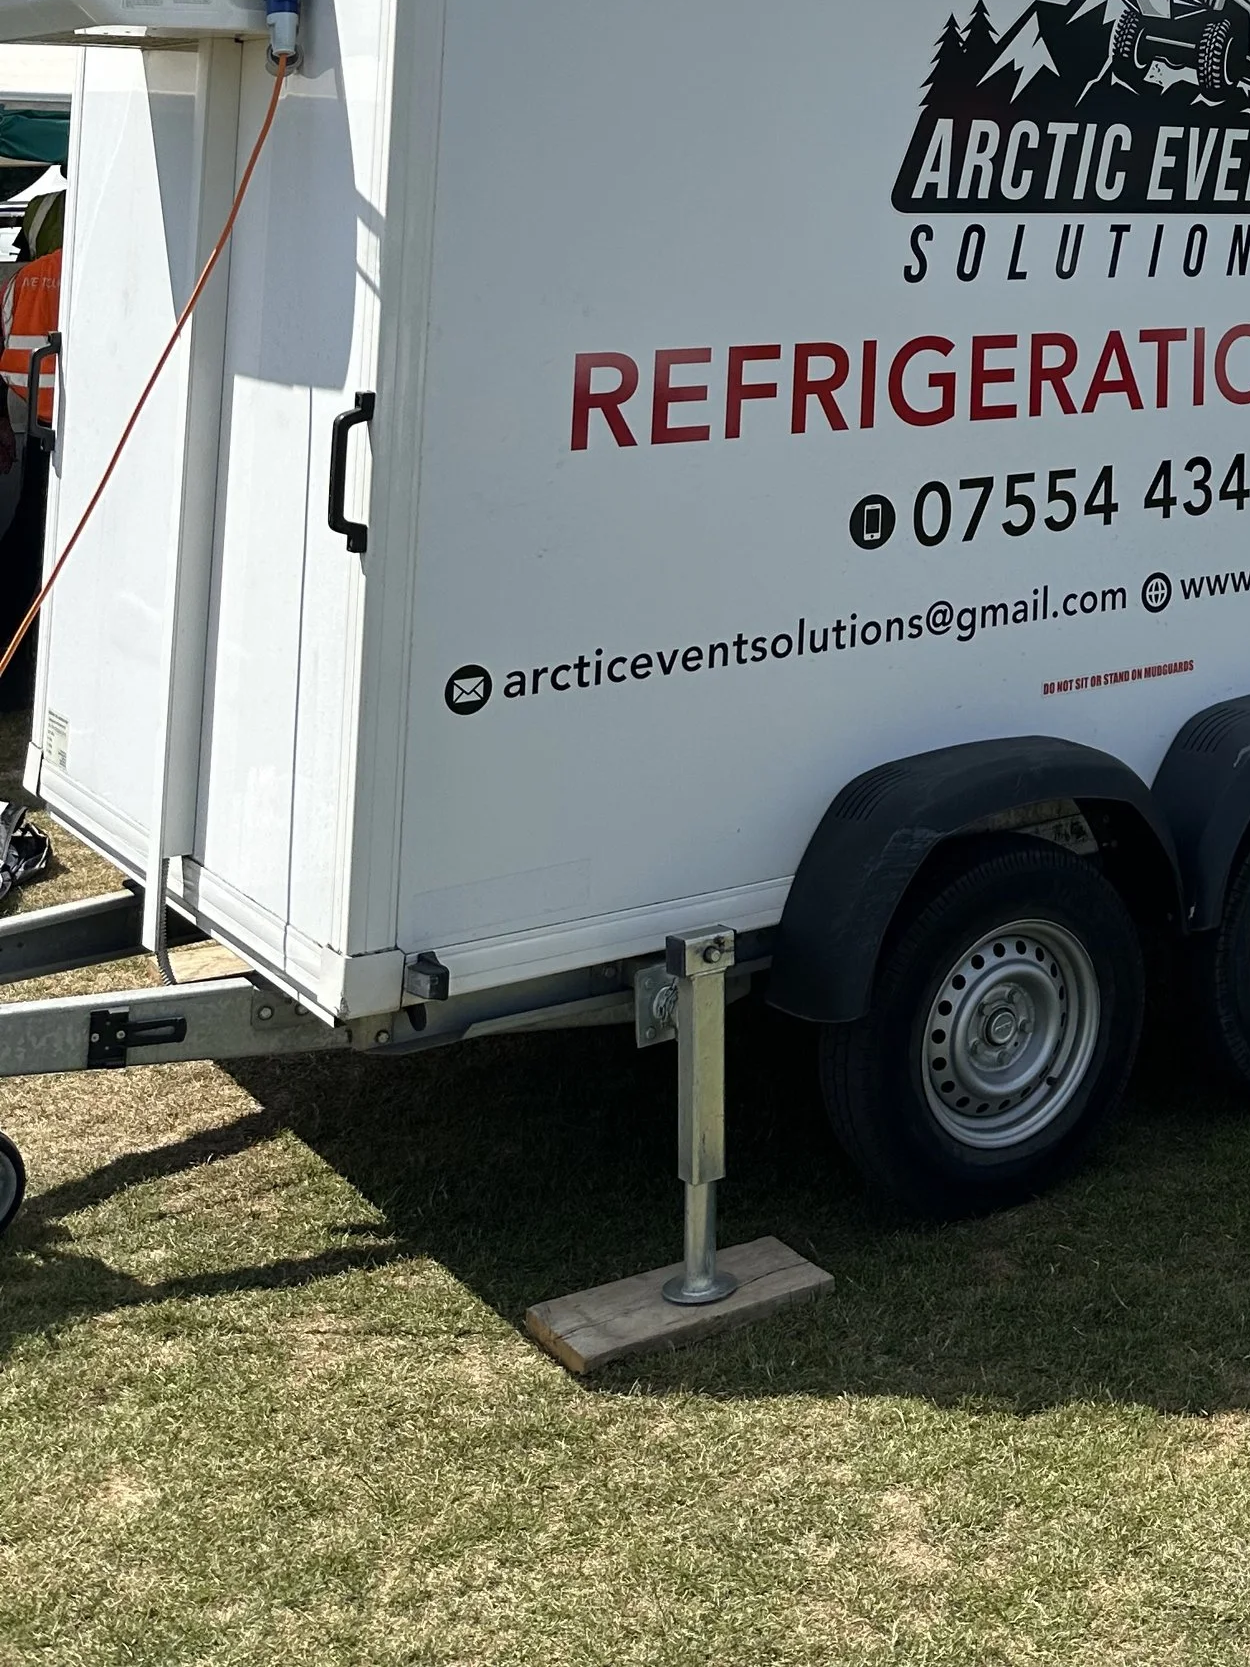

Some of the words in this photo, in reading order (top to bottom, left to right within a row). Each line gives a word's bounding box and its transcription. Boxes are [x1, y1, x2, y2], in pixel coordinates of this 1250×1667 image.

[911, 118, 1132, 201] ARCTIC
[913, 464, 1119, 547] 07554
[502, 584, 1127, 699] arcticeventsolutions@gmail.com
[1043, 682, 1055, 695] DO
[1056, 679, 1074, 692] NOT
[1075, 677, 1089, 690] SIT
[1090, 675, 1102, 688] OR
[1103, 670, 1130, 685] STAND
[1131, 668, 1143, 681] ON
[1143, 659, 1194, 679] MUDGUARDS
